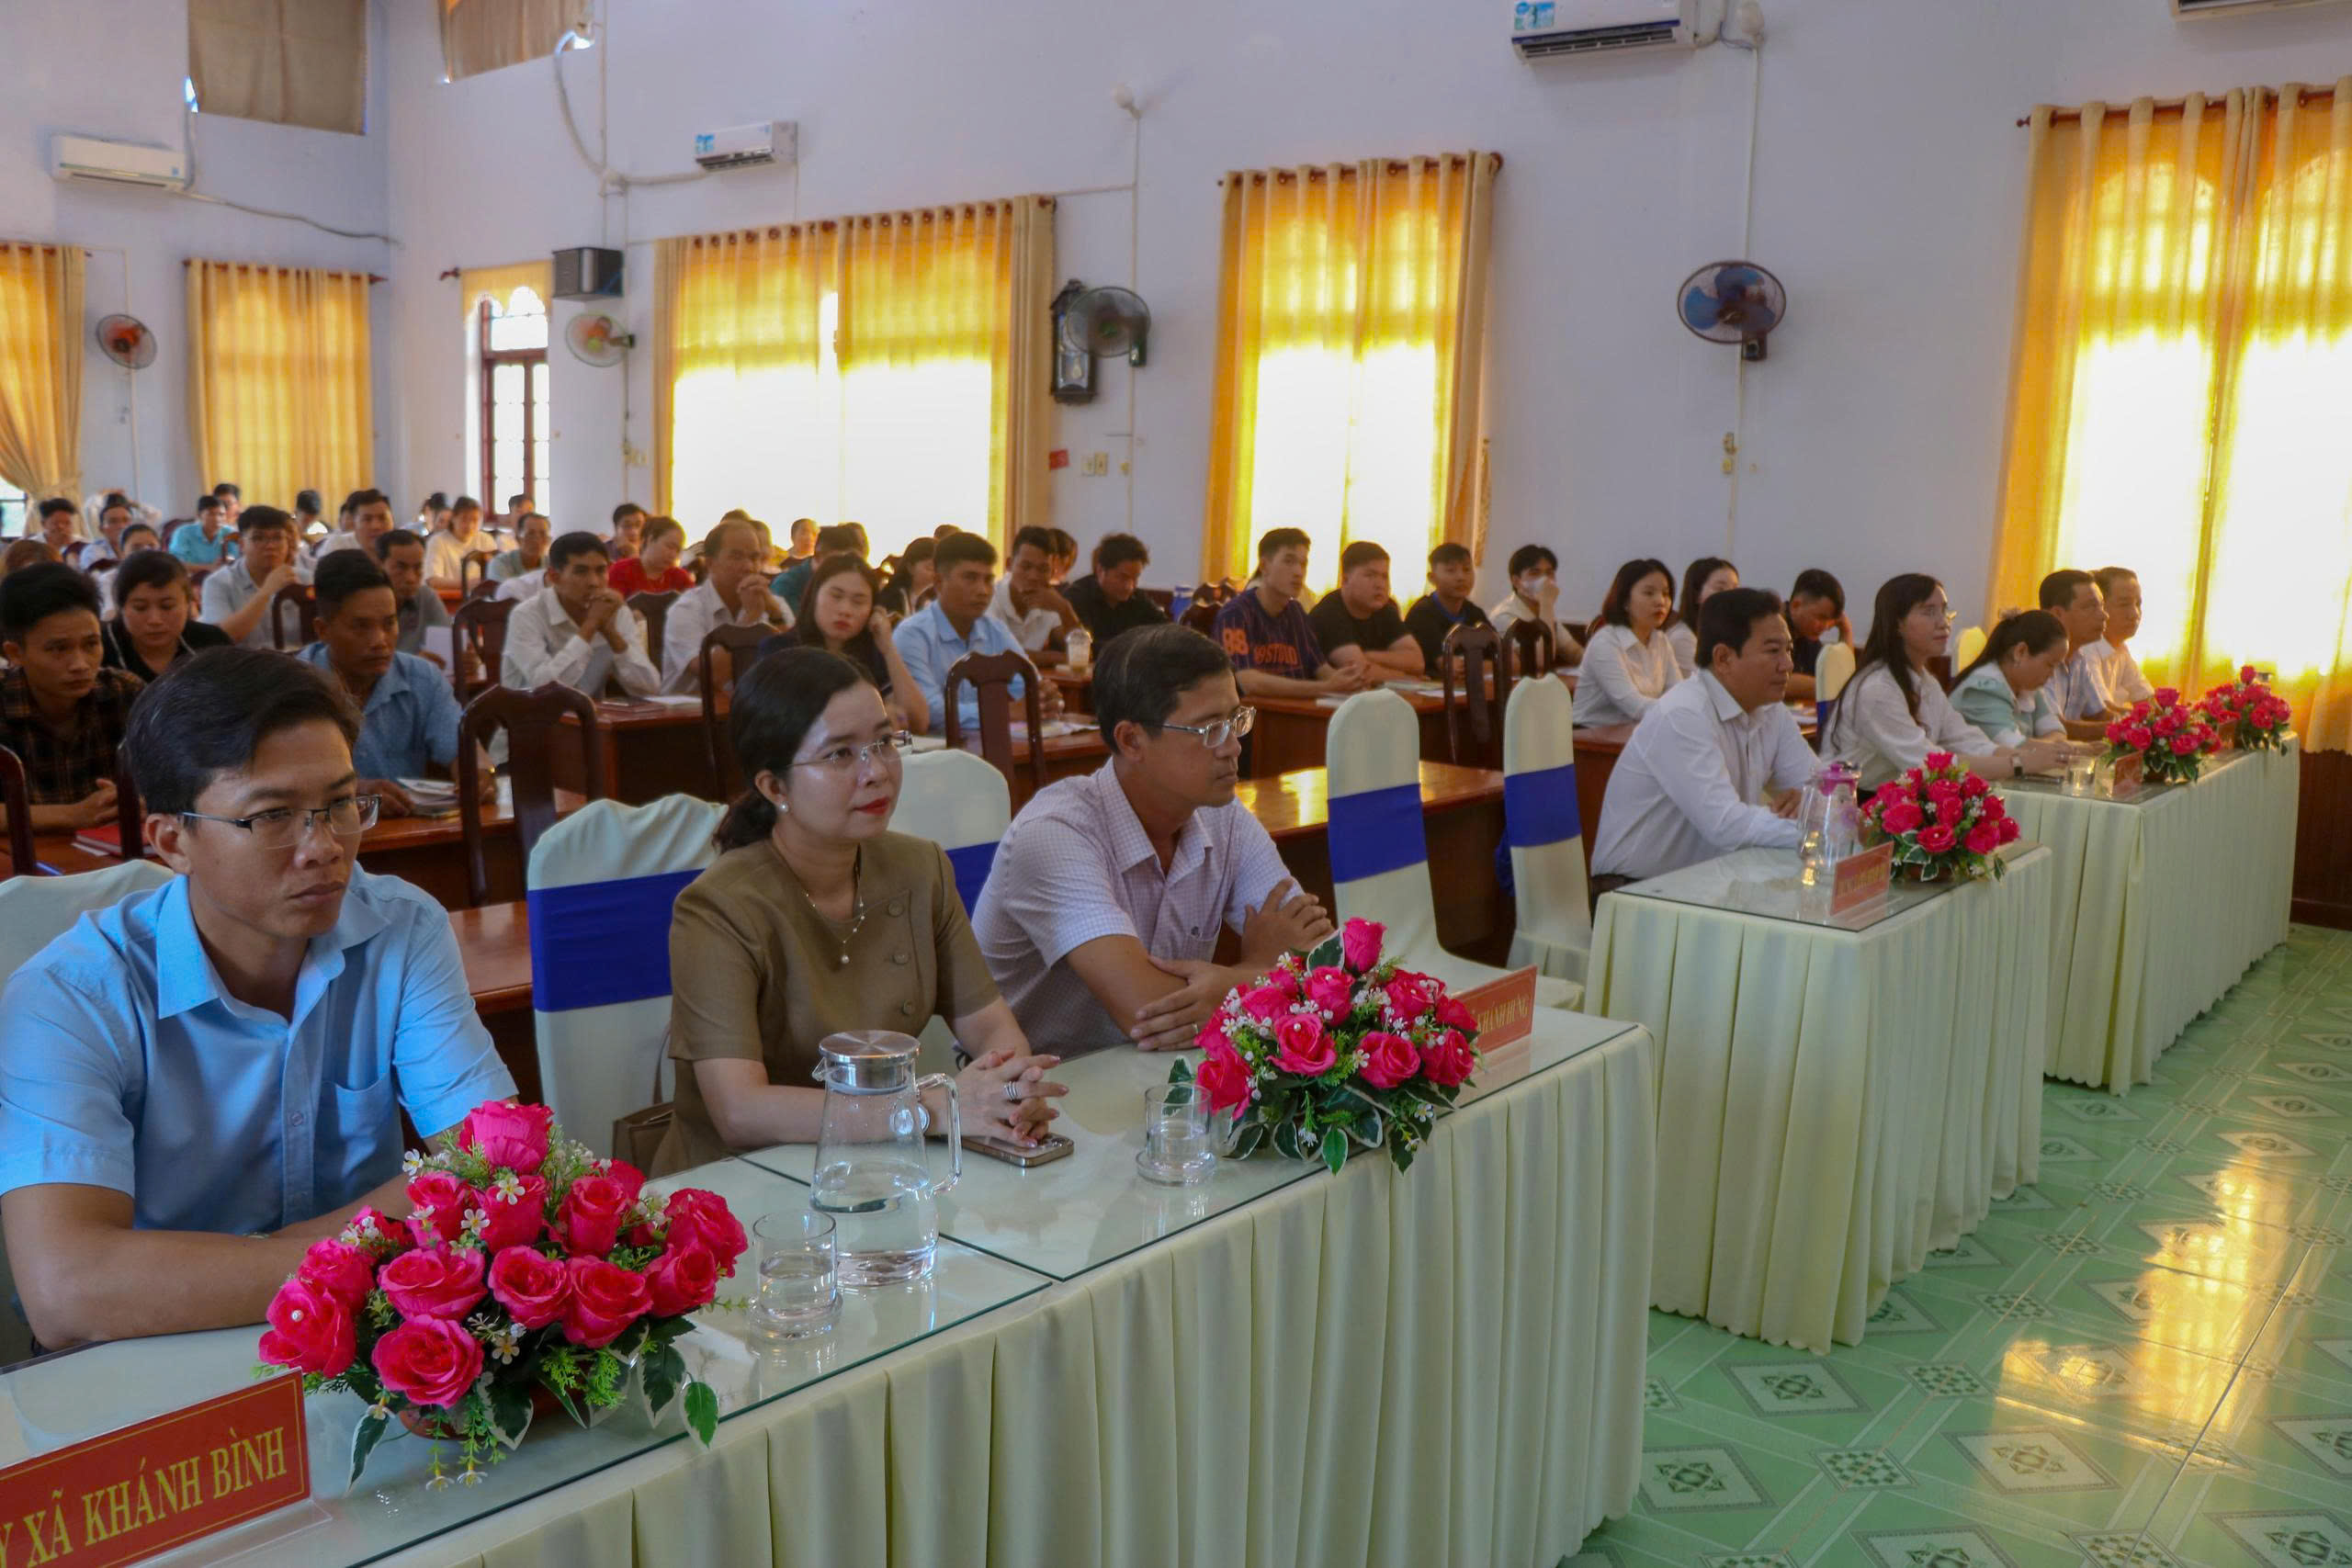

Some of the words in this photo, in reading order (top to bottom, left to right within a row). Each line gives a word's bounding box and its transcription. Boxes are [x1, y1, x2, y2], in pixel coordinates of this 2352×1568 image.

[23, 1487, 74, 1568] XÃ
[82, 1457, 204, 1547] KHÁNH
[210, 1427, 288, 1500] BÌNH
